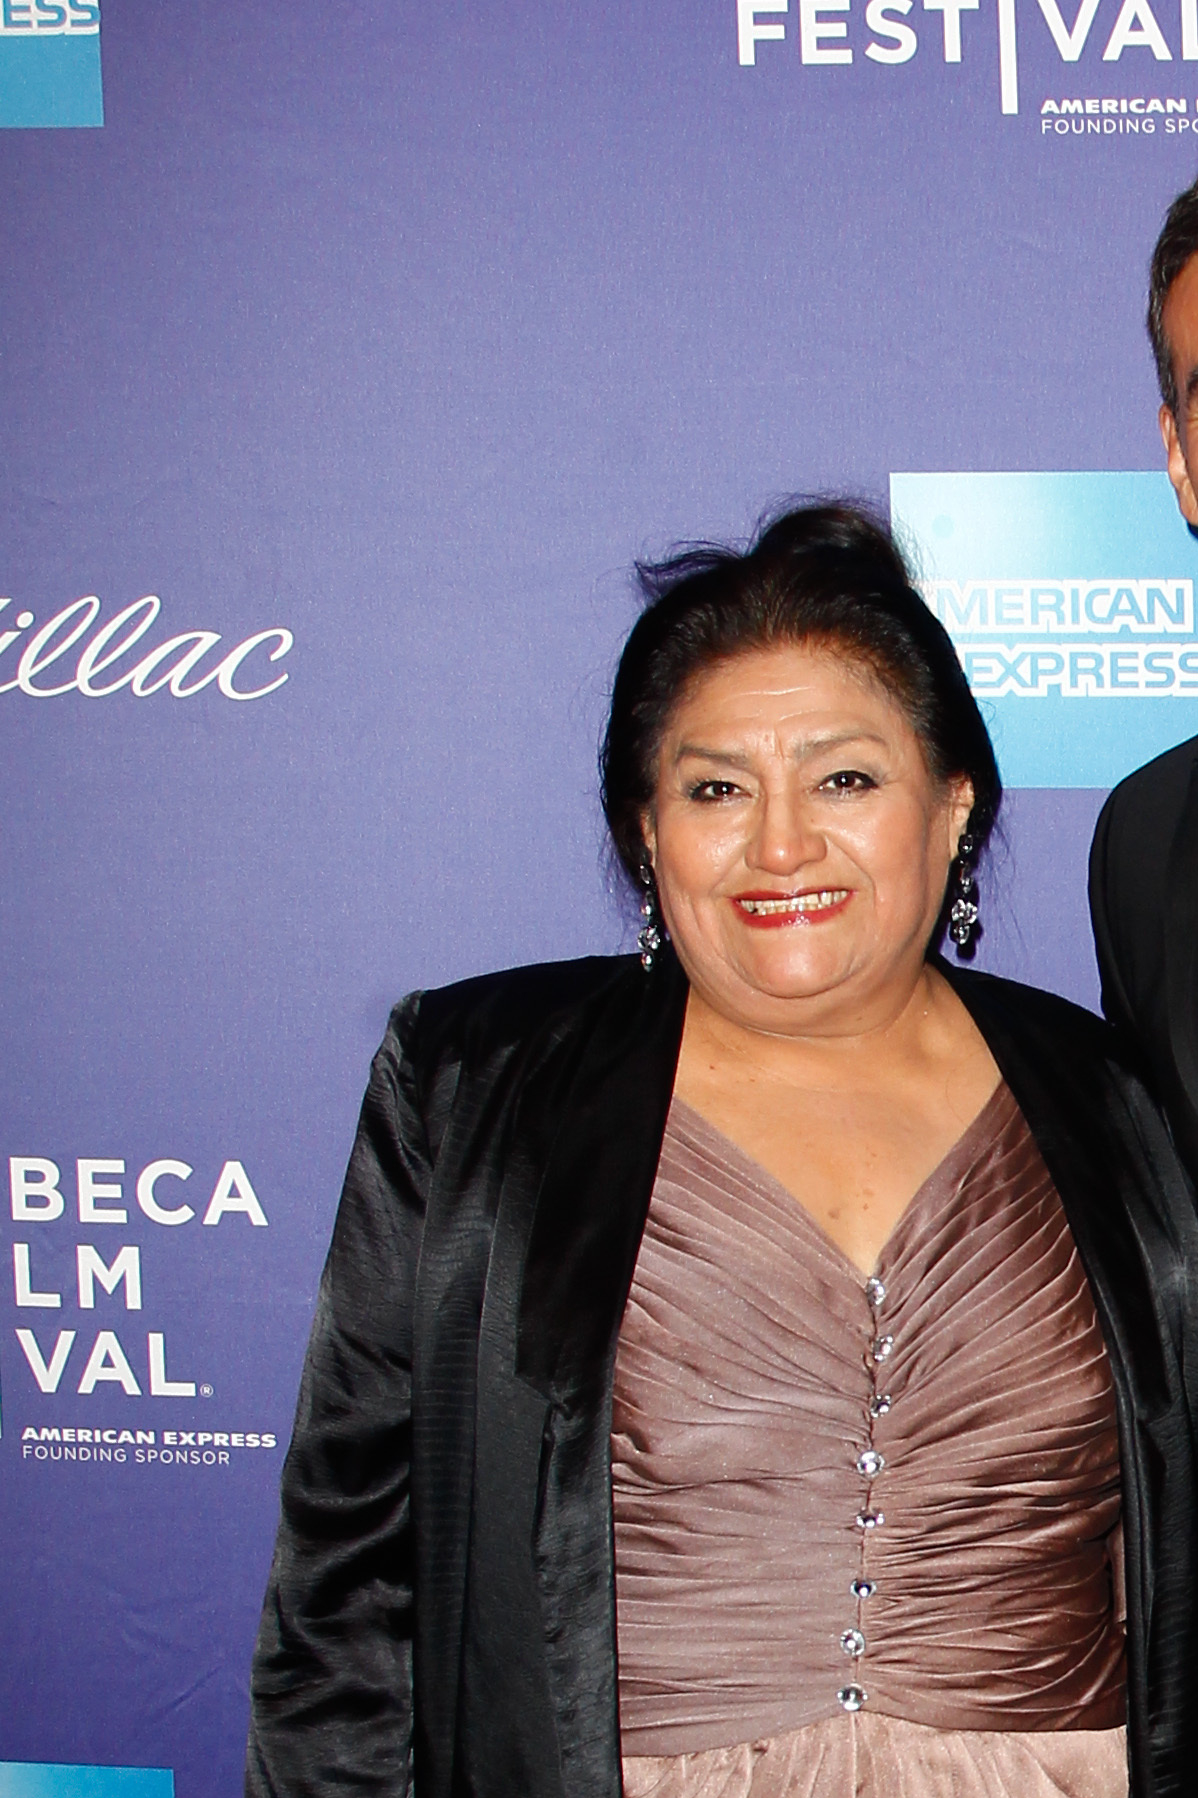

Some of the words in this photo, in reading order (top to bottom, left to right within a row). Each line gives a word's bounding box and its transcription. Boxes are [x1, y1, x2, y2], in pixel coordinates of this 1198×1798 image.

[1040, 99, 1188, 114] AMERICAN
[1040, 118, 1156, 134] FOUNDING
[930, 583, 1190, 630] MERICAN
[0, 594, 295, 701] illac
[9, 1156, 269, 1226] BECA
[13, 1242, 142, 1310] LM
[15, 1328, 197, 1397] VAL
[21, 1426, 155, 1446] AMERICAN
[163, 1430, 278, 1449] EXPRESS
[22, 1444, 128, 1463] FOUNDING
[135, 1448, 231, 1466] SPONSOR
